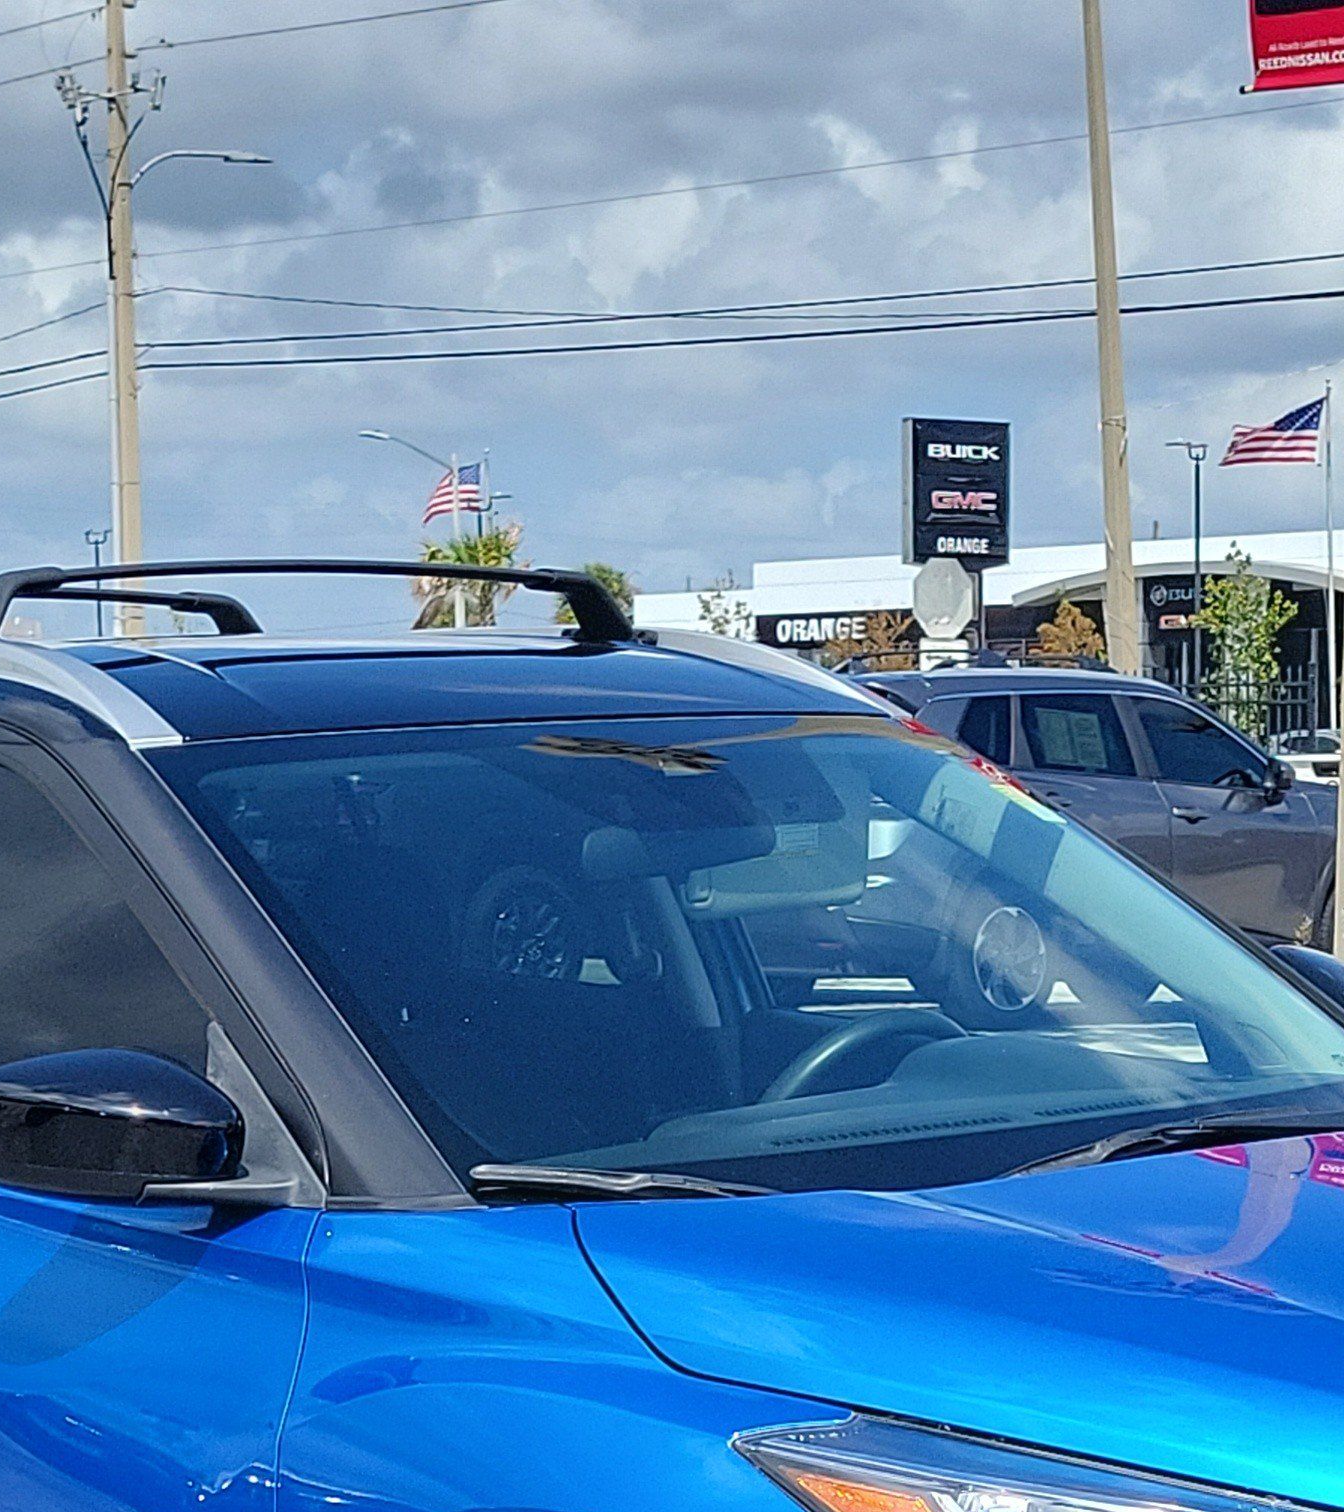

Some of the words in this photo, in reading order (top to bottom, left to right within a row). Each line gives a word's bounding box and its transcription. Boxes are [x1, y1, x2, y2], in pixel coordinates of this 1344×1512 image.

[927, 443, 1000, 460] BUICK
[931, 490, 997, 510] GMC
[937, 536, 990, 554] ORANGE
[776, 616, 867, 643] ORANGE
